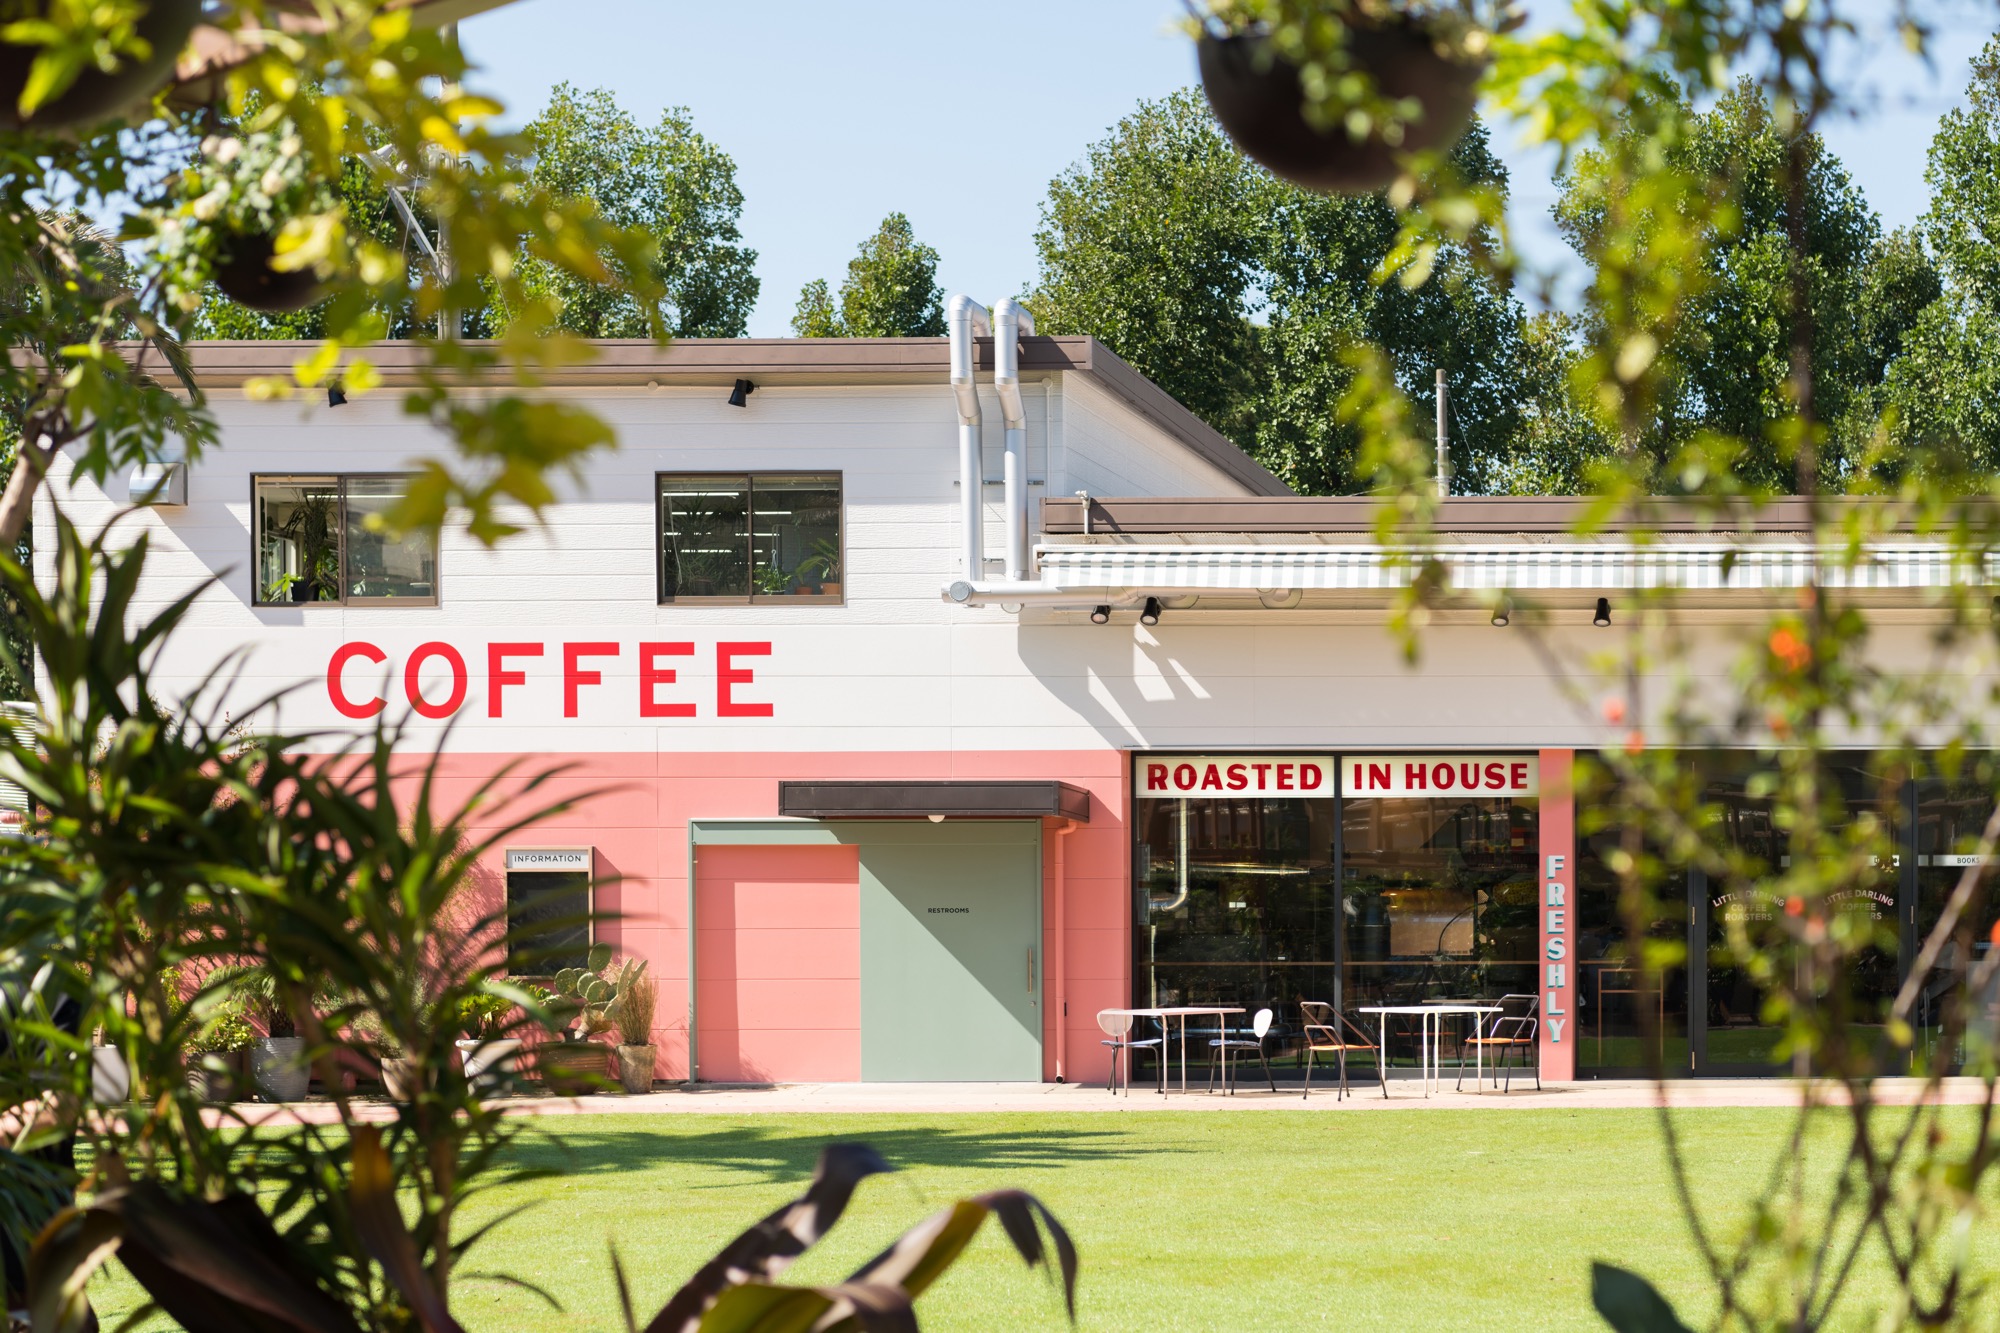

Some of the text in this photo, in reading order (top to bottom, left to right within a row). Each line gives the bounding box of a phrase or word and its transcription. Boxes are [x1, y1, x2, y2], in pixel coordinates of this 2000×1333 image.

[327, 641, 774, 719] COFFEE
[1147, 762, 1528, 791] ROASTED IN HOUSE
[514, 855, 582, 863] INFORMATION
[1855, 889, 1894, 906] DARLING
[1731, 904, 1767, 912] COFFEE
[1725, 913, 1773, 921] ROASTERS
[1546, 855, 1567, 1042] FRESHLY
